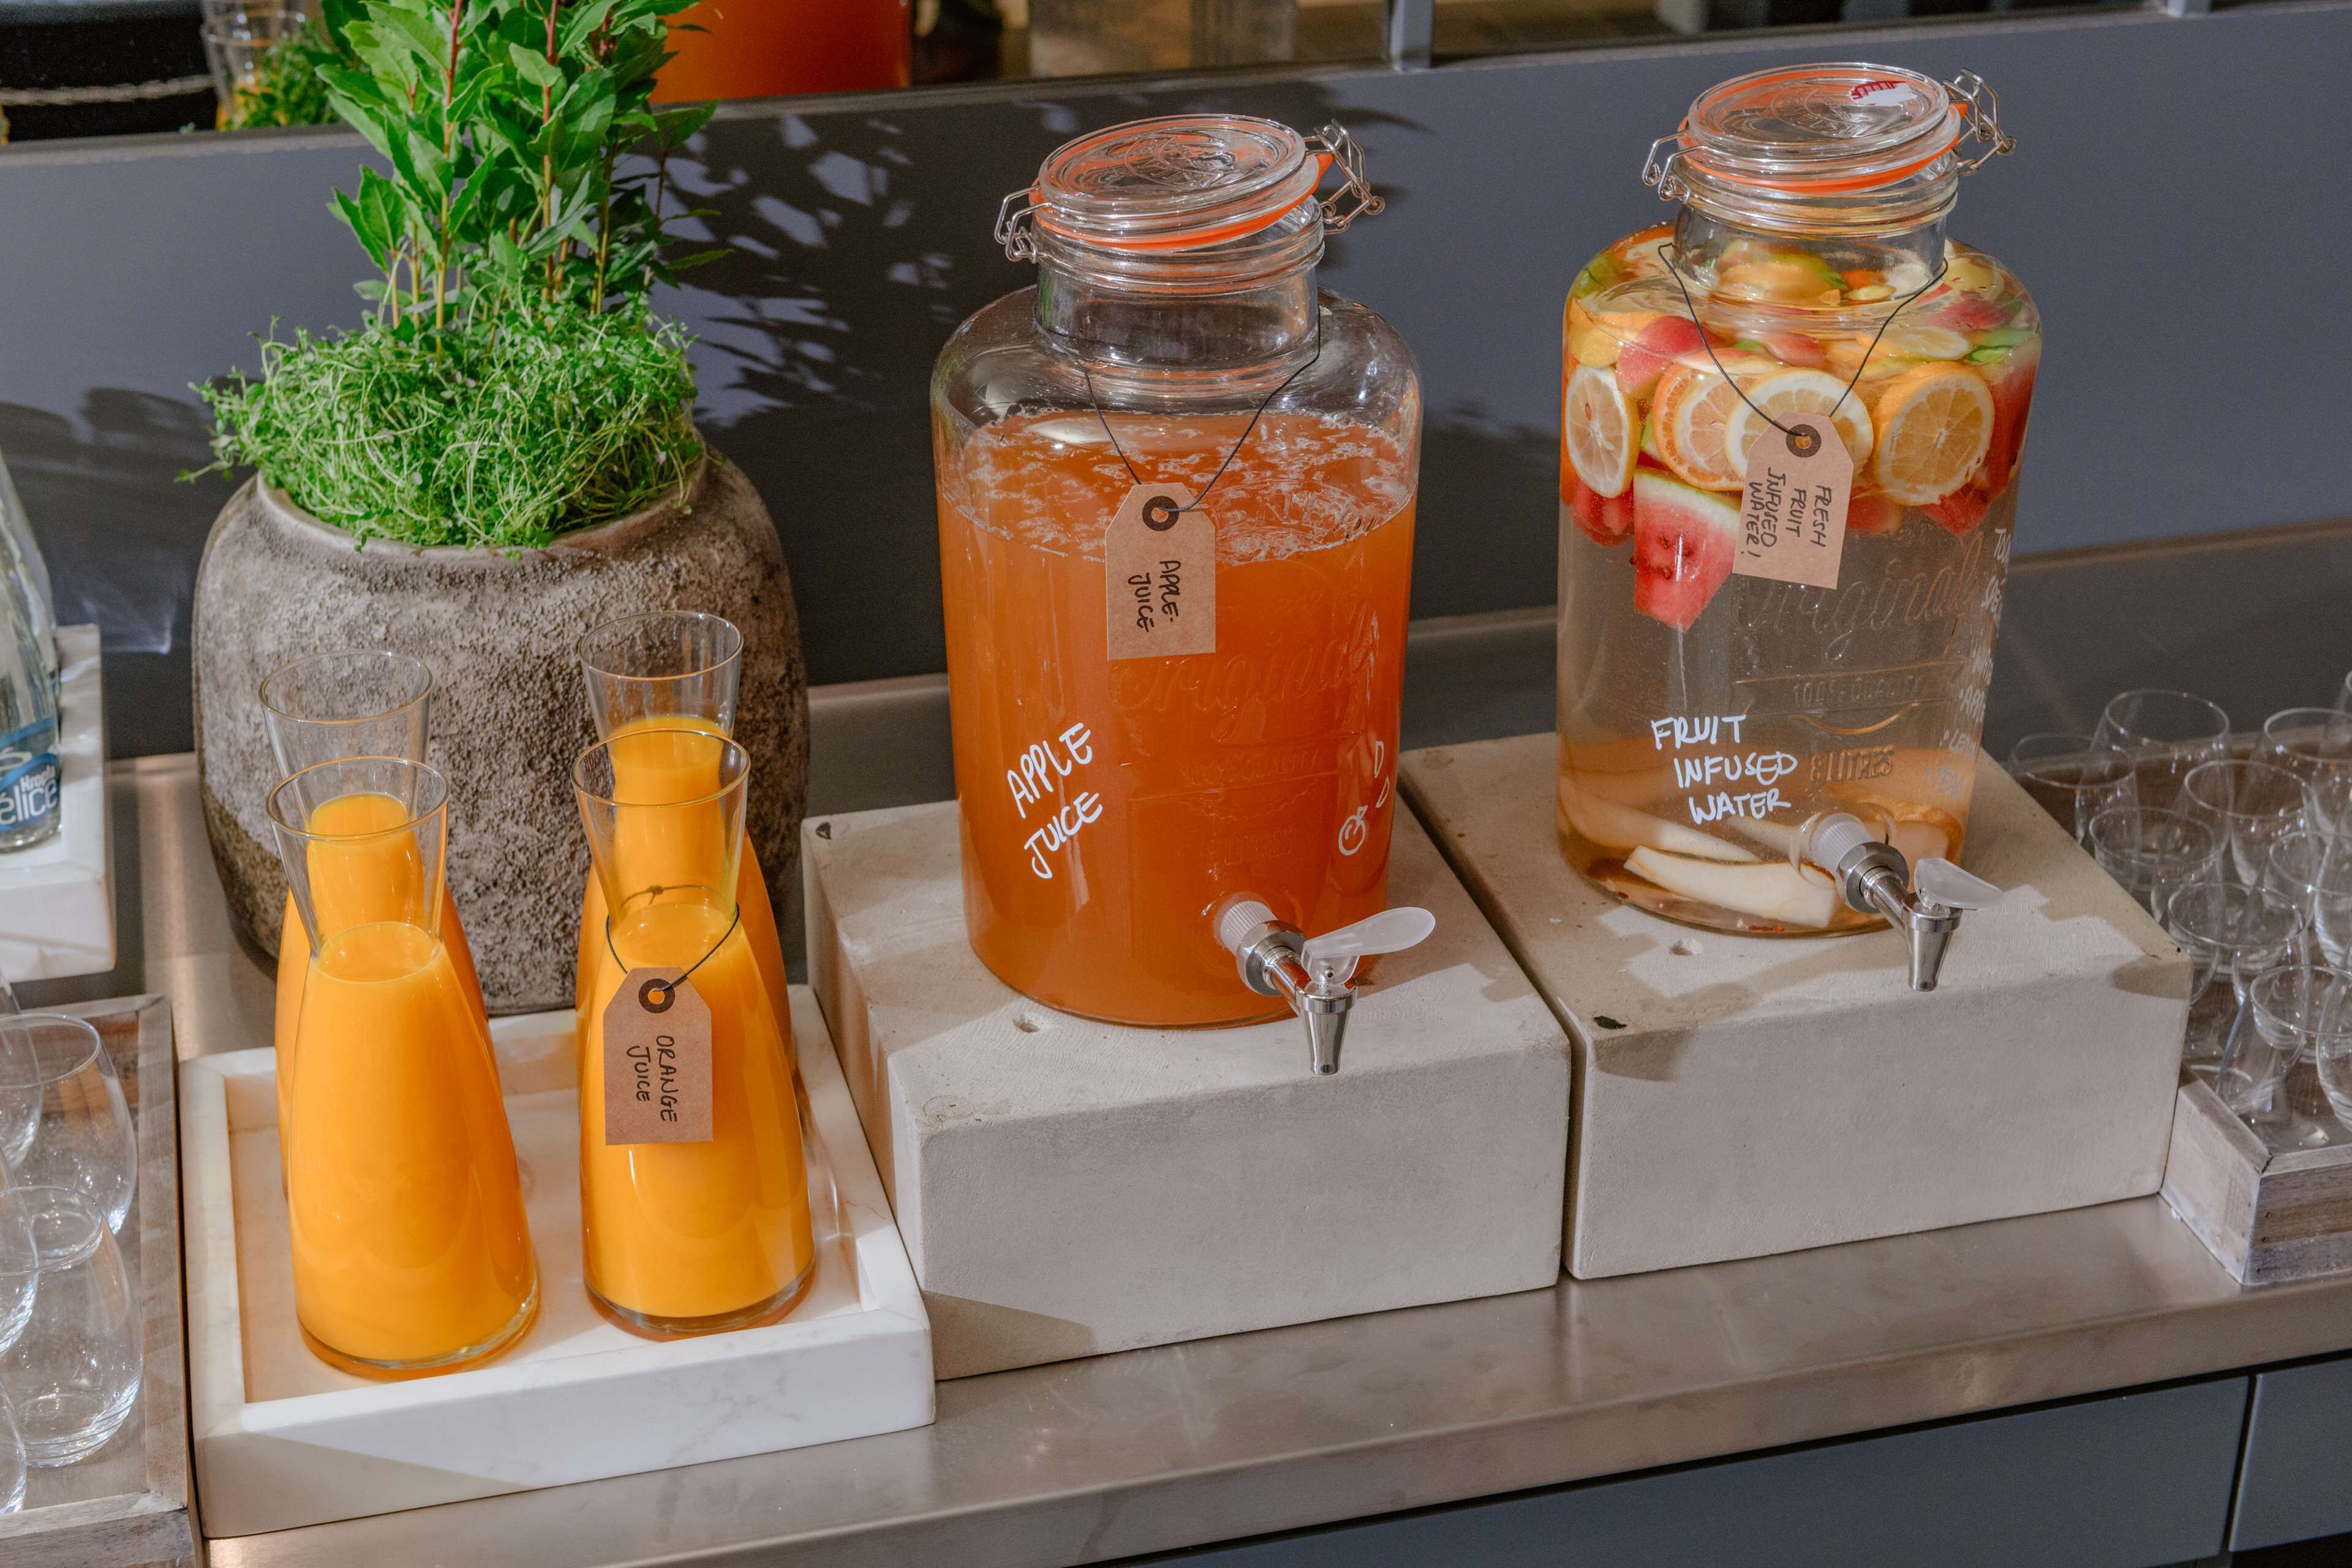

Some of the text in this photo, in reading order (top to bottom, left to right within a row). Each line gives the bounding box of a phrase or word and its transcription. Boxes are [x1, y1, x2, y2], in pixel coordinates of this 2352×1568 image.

[1760, 467, 1787, 548] INFUSED
[1785, 488, 1807, 538] FRUIT
[1809, 484, 1833, 548] FRESH
[1127, 571, 1155, 633] JUICE
[1649, 713, 1748, 750] FRUIT
[1007, 722, 1094, 820] APPLE
[1673, 751, 1799, 790] INFUSED
[1826, 743, 1896, 782] LITRES
[1022, 790, 1104, 880] JUICE
[1688, 787, 1792, 824] WATER
[626, 1045, 652, 1102] JUICE
[655, 1035, 679, 1123] ORANGE
